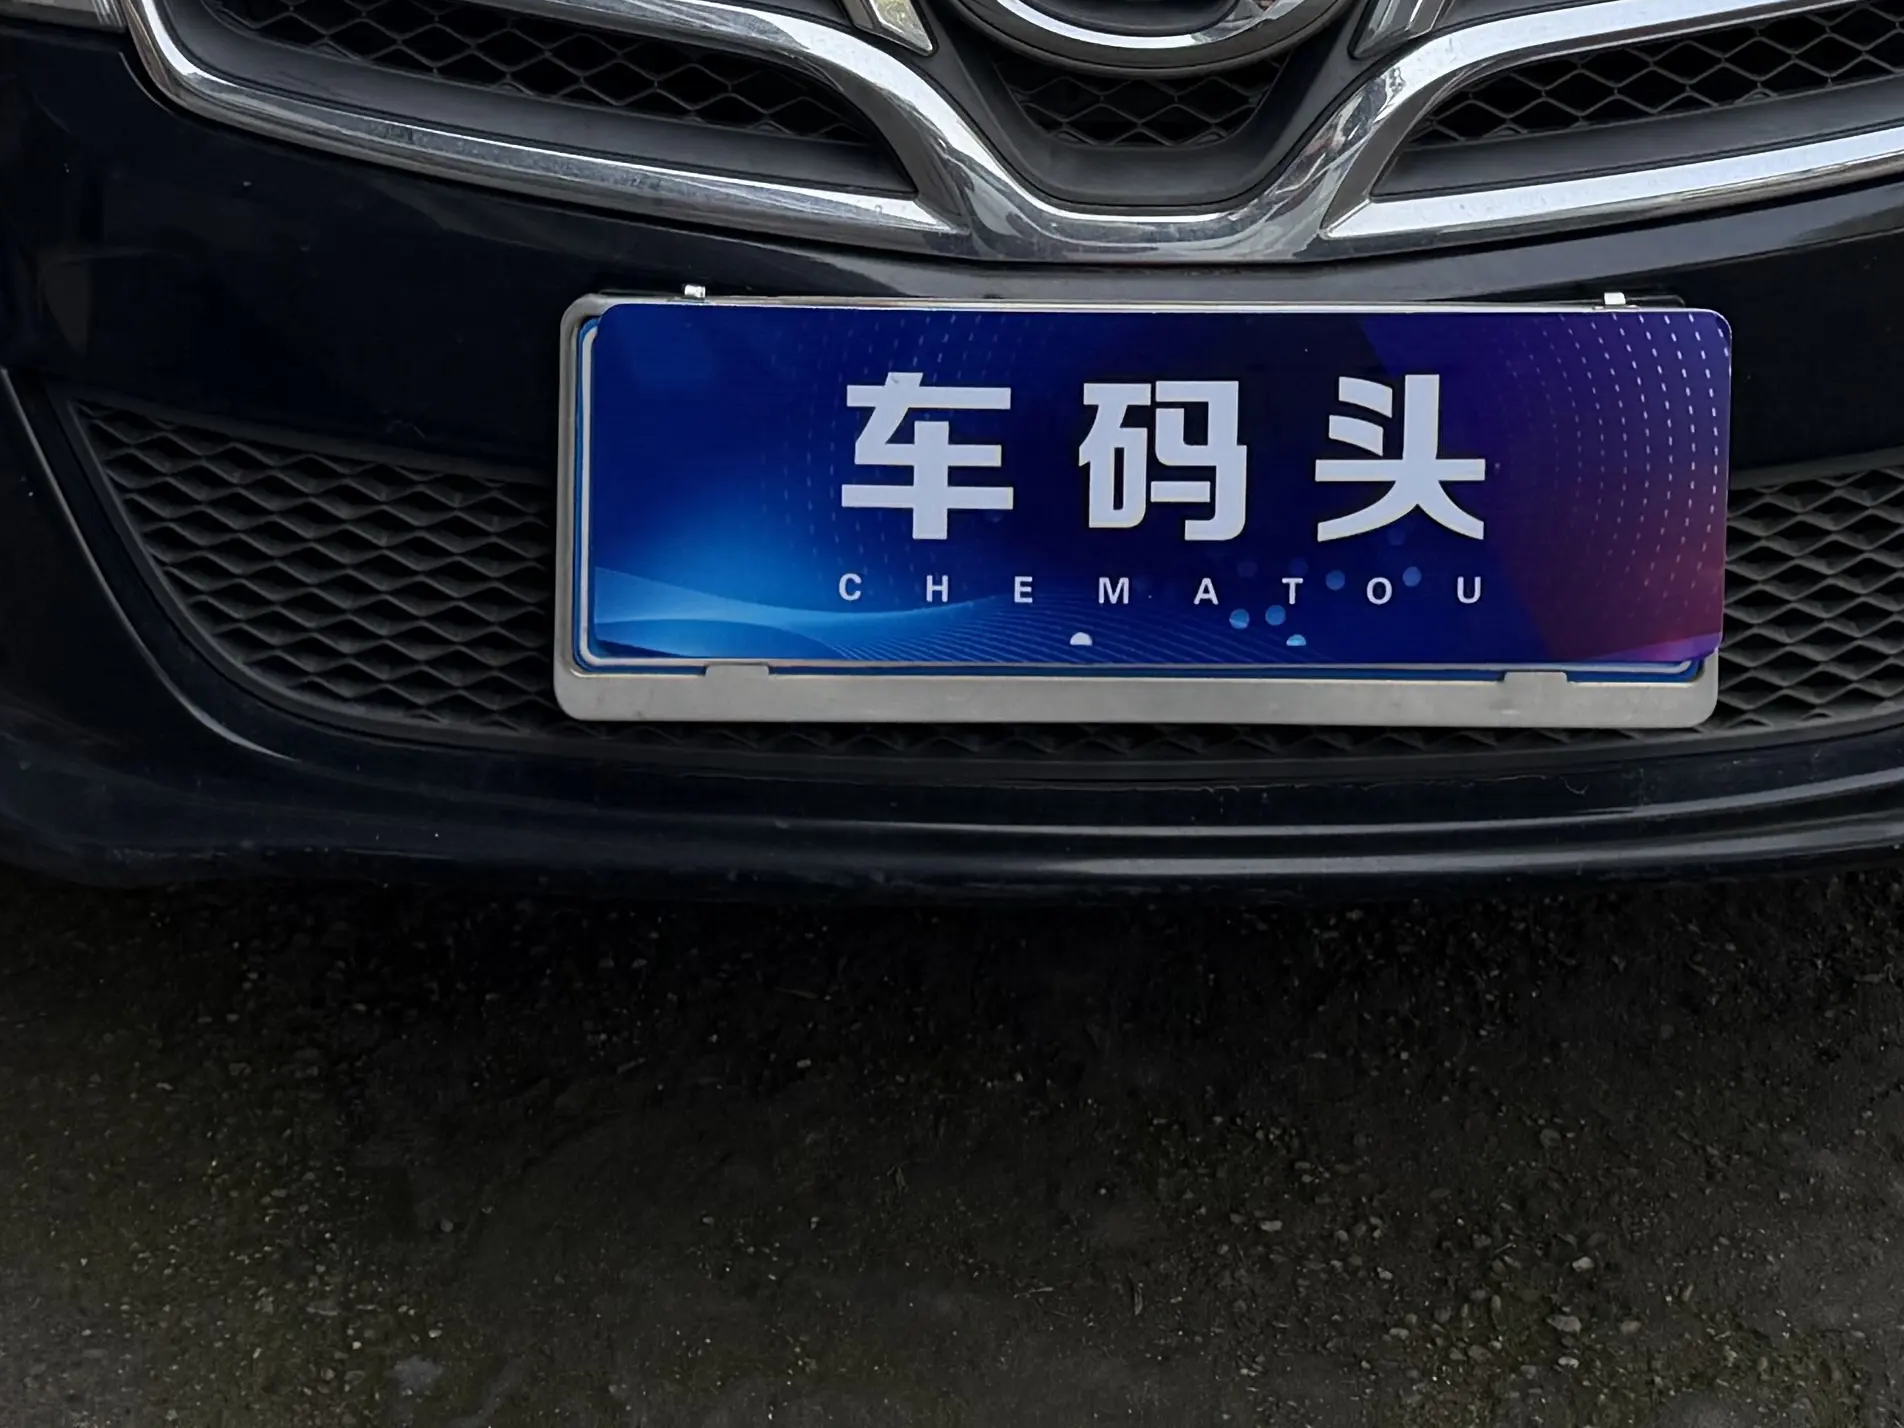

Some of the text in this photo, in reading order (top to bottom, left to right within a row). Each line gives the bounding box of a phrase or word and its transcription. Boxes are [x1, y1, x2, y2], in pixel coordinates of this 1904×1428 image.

[840, 371, 1488, 543] 车码头
[838, 573, 1483, 607] CHEMATOU
